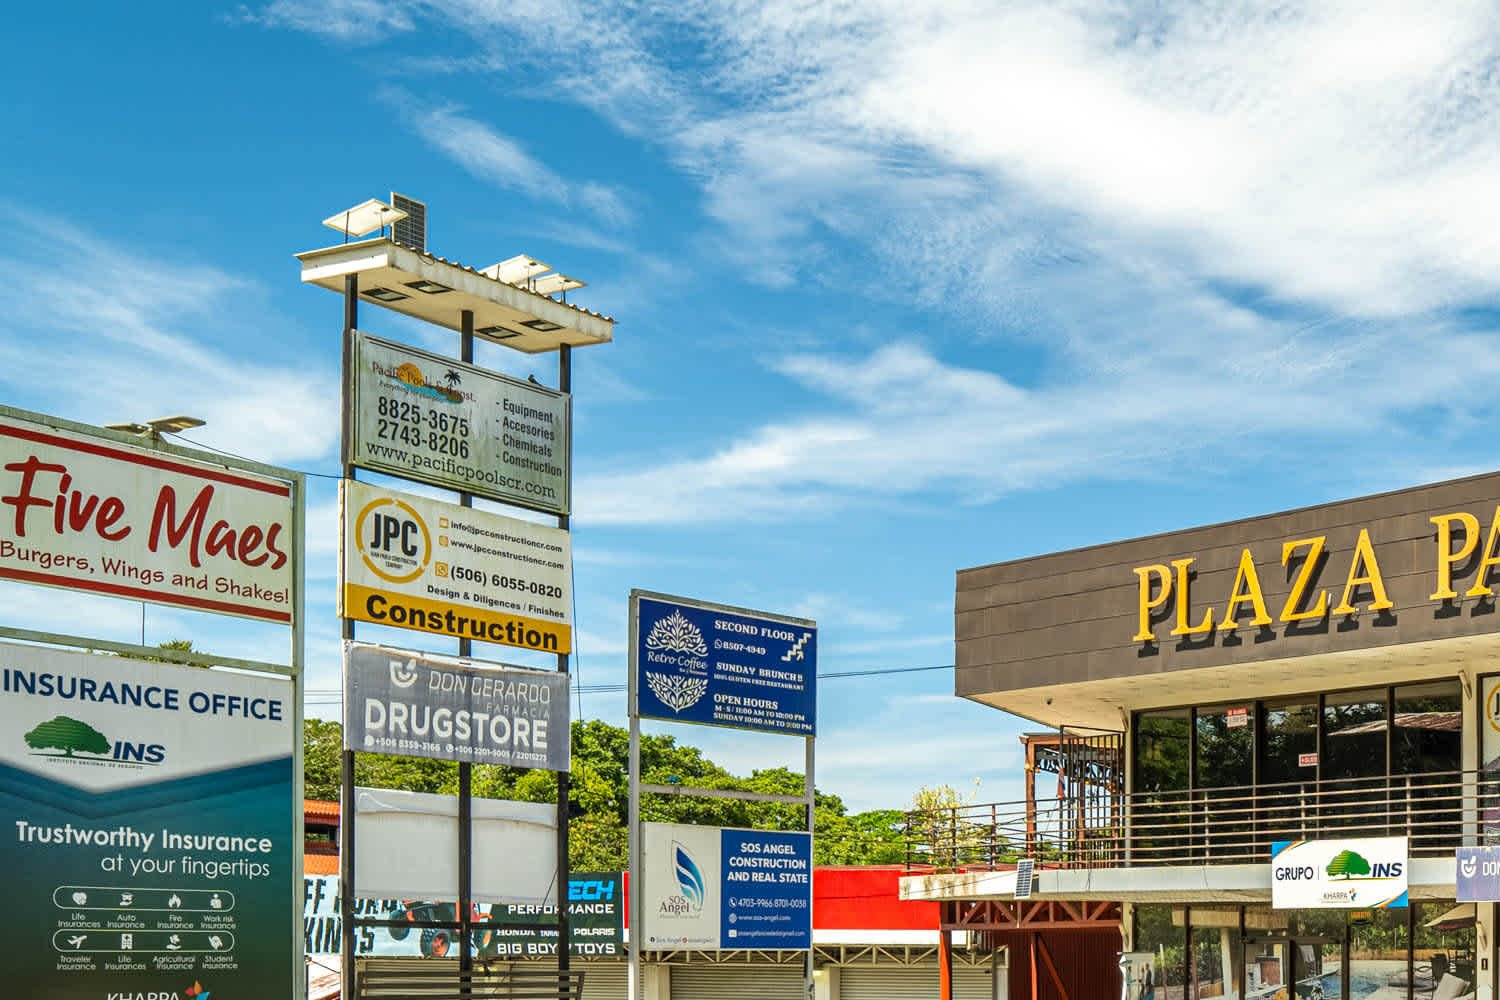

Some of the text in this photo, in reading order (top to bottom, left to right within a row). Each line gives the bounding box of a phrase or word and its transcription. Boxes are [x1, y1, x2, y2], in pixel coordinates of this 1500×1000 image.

[378, 396, 469, 438] 8825-3675
[503, 398, 553, 424] Equipment
[502, 416, 555, 441] Accesories
[378, 418, 469, 460] 2743-8206
[502, 434, 552, 458] Chemicals
[366, 441, 556, 499] www.pacificpoolscr.com
[502, 451, 562, 478] Construction
[1, 455, 287, 570] Five Maes
[370, 513, 418, 557] JPC
[0, 540, 289, 604] Burgers, Wings and Shakes!
[451, 565, 562, 599] (506) 6055-0820
[1133, 527, 1394, 642] PLAZA
[427, 585, 460, 600] Design
[463, 591, 470, 600] &
[528, 604, 565, 619] Finishes
[366, 594, 558, 650] Construction
[714, 620, 795, 641] SECOND FLOOR
[647, 651, 708, 670] Retro Coffee
[716, 662, 756, 675] SUNDAY
[3, 668, 283, 721] INSURANCE OFFICE
[429, 670, 550, 704] DON GERARDO
[714, 694, 779, 710] OPEN HOURS
[486, 703, 550, 719] FARMACIA
[714, 712, 743, 722] SUNDAY
[365, 698, 548, 749] DRUGSTORE
[113, 740, 166, 763] INS
[15, 821, 272, 853] Trustworthy Insurance
[741, 842, 796, 855] SOS ANGEL
[101, 853, 270, 880] at your fingertips
[729, 857, 806, 870] CONSTRUCTION
[1372, 862, 1402, 878] INS
[727, 872, 808, 884] AND REAL STATE
[1275, 866, 1314, 880] GRUPO
[659, 901, 689, 915] Angel
[669, 896, 686, 904] SOS
[58, 920, 101, 928] Insurances
[72, 913, 86, 921] Life
[107, 921, 145, 929] Insurance
[157, 921, 194, 929] Insurance
[574, 928, 616, 936] POLARIS
[498, 943, 616, 954] BIG TOYS
[57, 962, 96, 970] Insurance
[105, 962, 146, 970] Insurances
[153, 956, 195, 965] Agricultural
[156, 962, 193, 970] Insurance
[205, 955, 233, 963] Student
